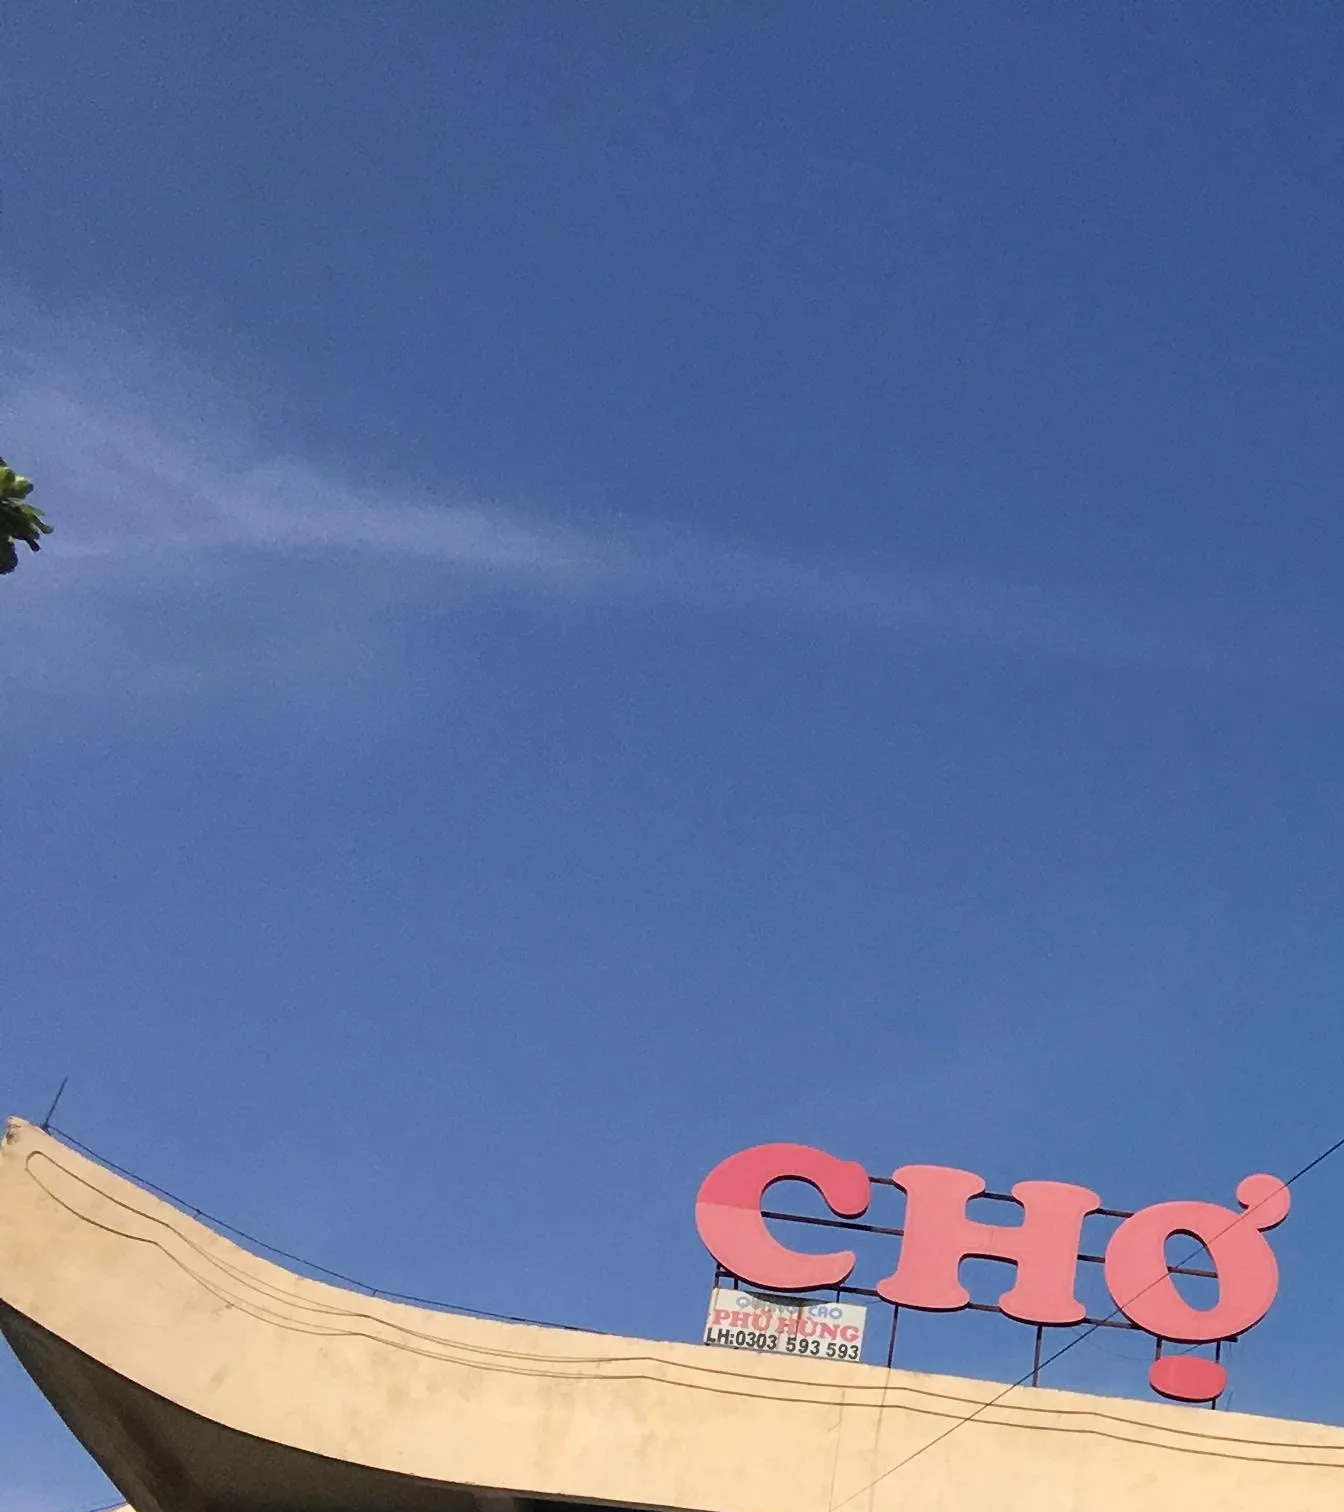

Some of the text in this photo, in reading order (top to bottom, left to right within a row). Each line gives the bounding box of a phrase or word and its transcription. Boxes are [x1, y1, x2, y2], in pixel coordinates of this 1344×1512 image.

[694, 1142, 1291, 1402] CHỢ
[785, 1336, 821, 1356] 593
[825, 1342, 860, 1360] 593
